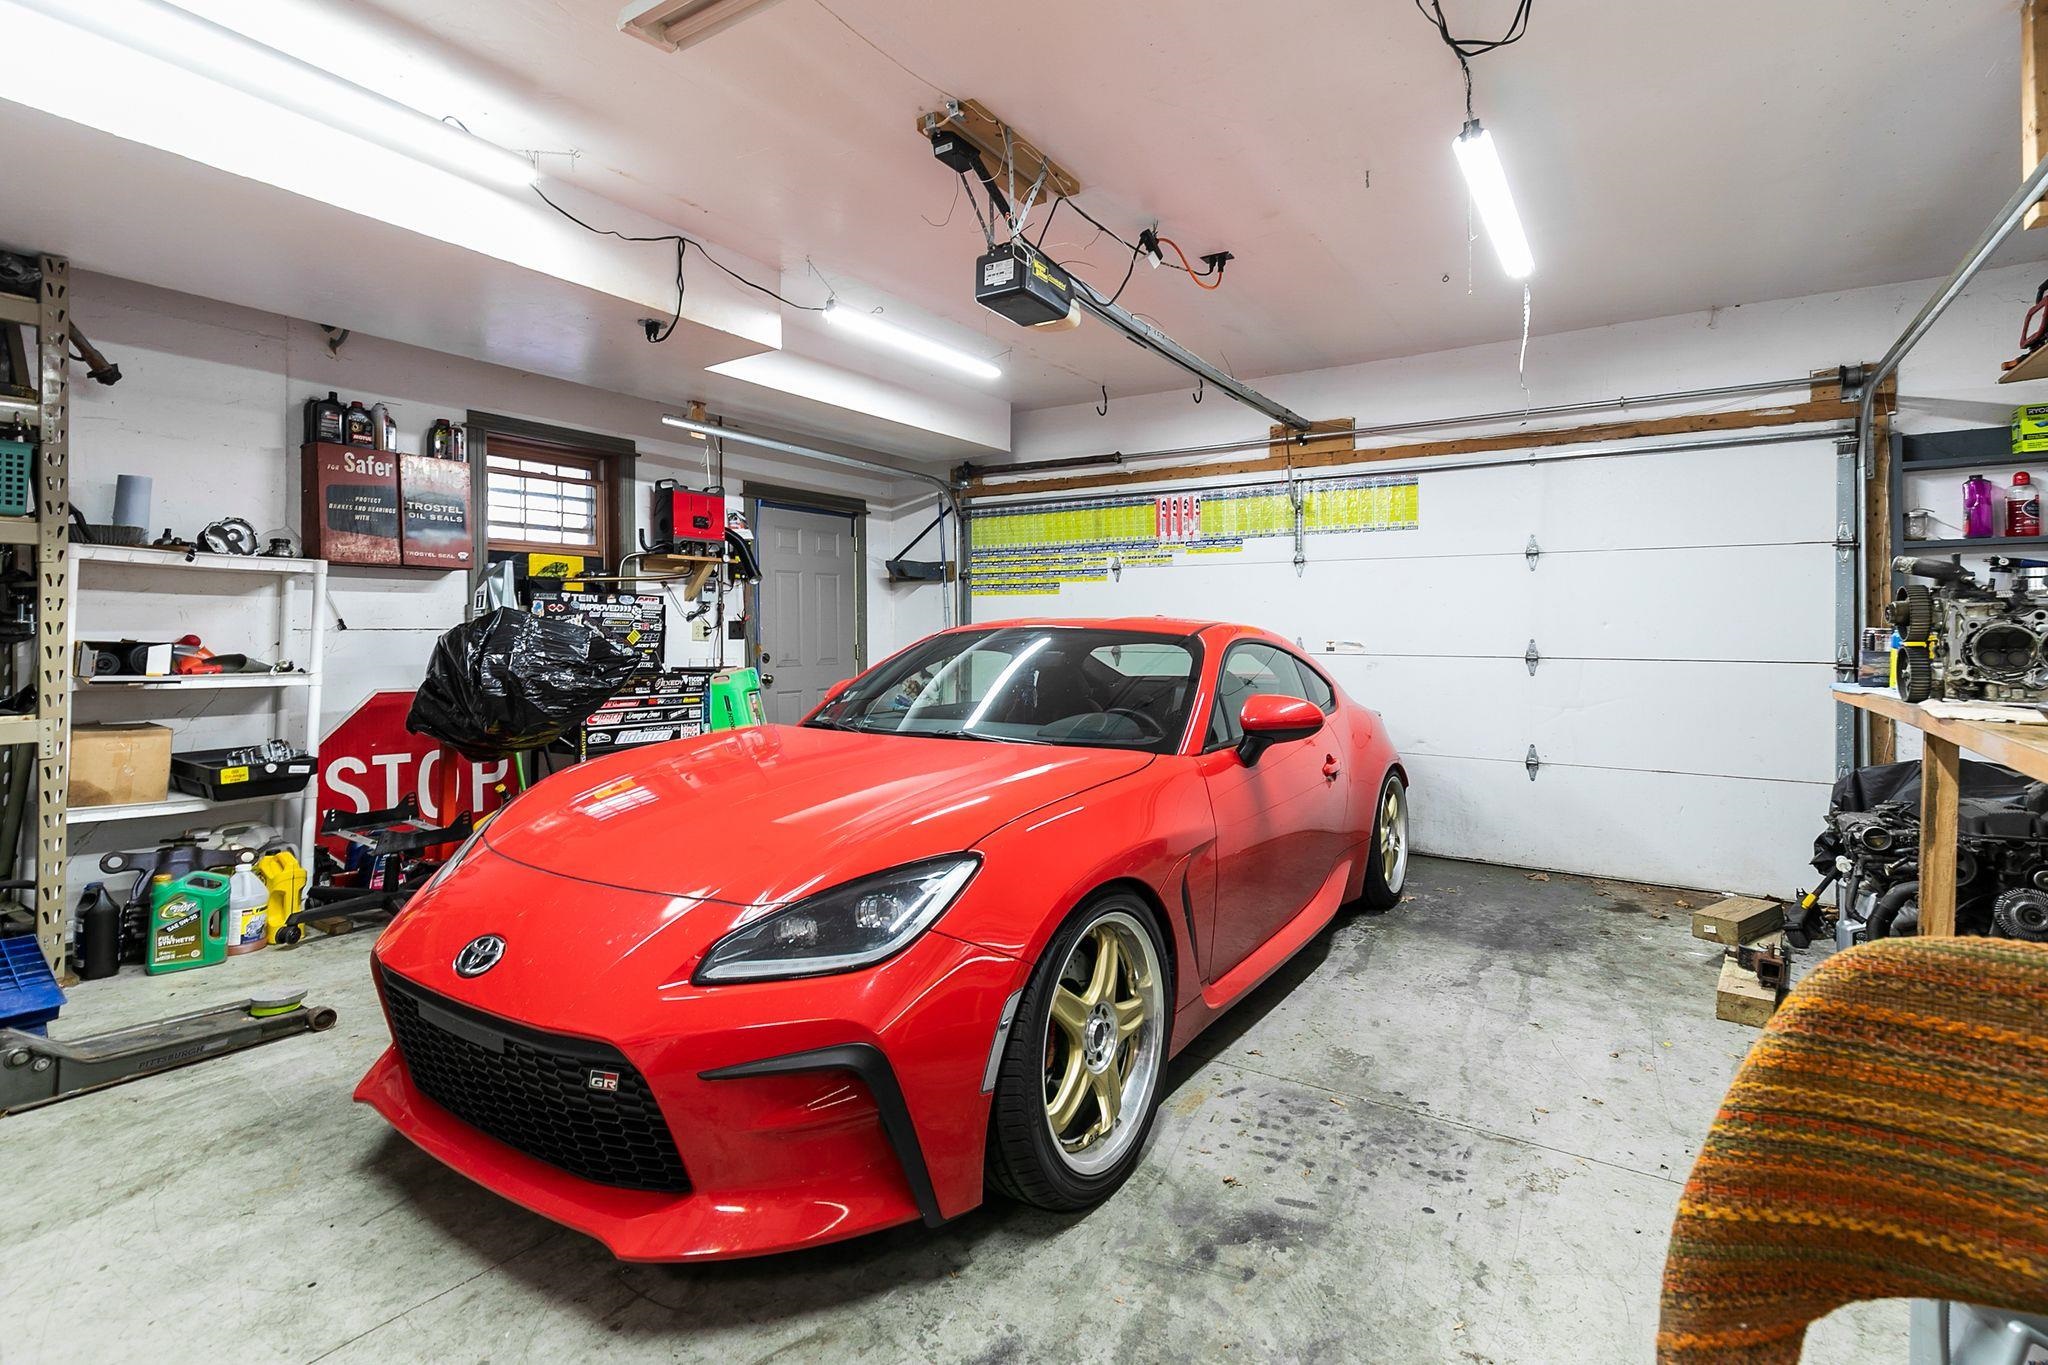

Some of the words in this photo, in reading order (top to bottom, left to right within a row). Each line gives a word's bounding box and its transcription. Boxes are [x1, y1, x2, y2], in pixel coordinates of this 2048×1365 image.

[326, 463, 340, 471] FOR
[343, 452, 394, 477] Safer
[406, 501, 464, 514] TROSTEL
[408, 512, 427, 520] OIL
[429, 513, 463, 523] SEALS
[405, 550, 437, 558] TROSTEL
[571, 593, 598, 603] TEIN
[580, 603, 620, 611] IMPROVED
[323, 750, 509, 819] STOP
[157, 936, 196, 947] SYNTHETIC
[591, 1077, 617, 1089] GR
